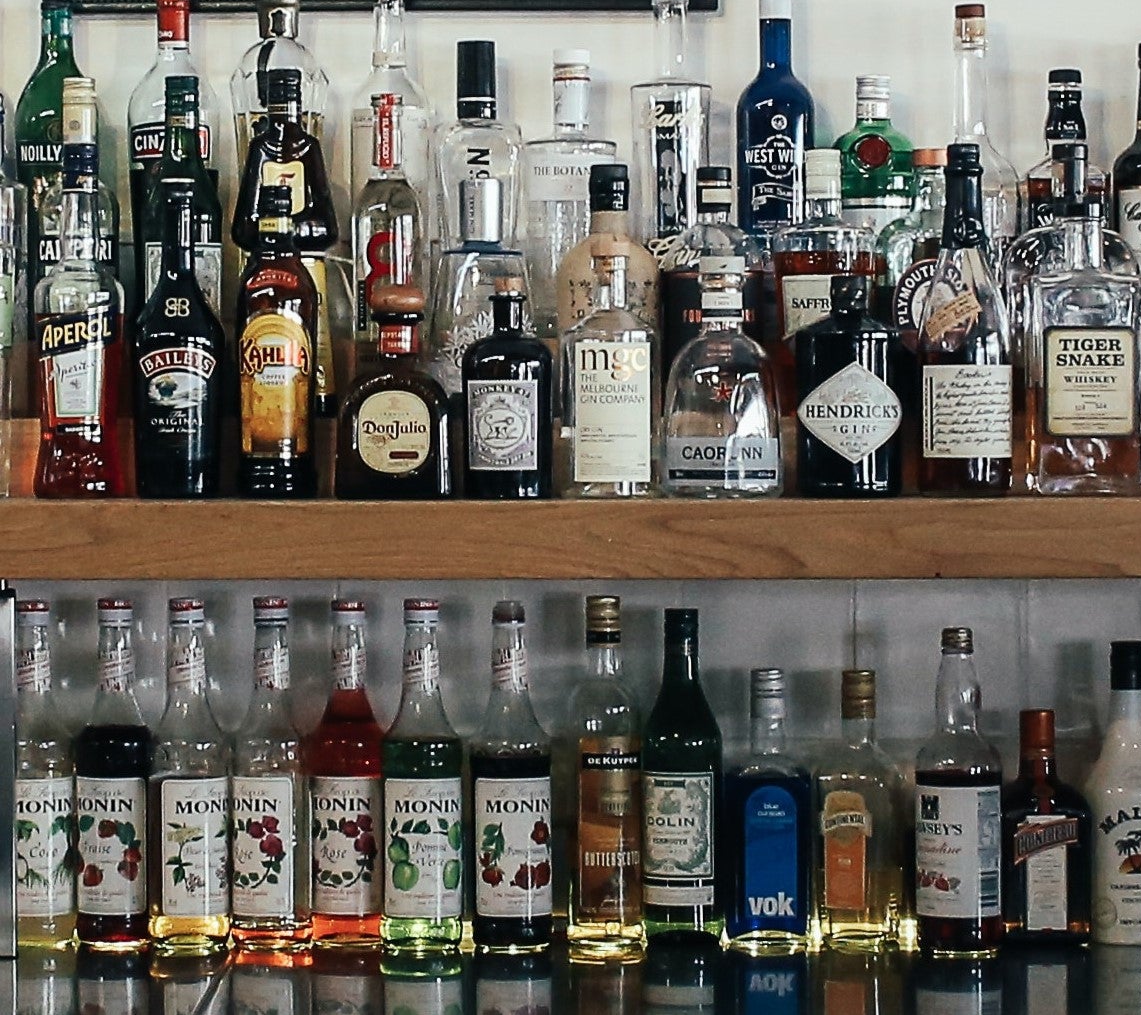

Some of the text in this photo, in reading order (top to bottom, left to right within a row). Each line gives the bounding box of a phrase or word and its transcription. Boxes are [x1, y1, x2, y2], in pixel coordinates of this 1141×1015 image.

[20, 144, 62, 162] NOILLY
[744, 148, 774, 164] WEST
[41, 316, 112, 351] APEROL
[1058, 338, 1122, 352] TIGER
[144, 348, 211, 373] BAILEYS
[1056, 353, 1125, 367] SNAKE
[580, 373, 598, 383] THE
[1063, 375, 1117, 384] WHISKEY
[580, 384, 639, 394] MELBOURNE
[580, 394, 598, 404] GIN
[805, 404, 899, 419] HENDRICK'S
[394, 799, 460, 814] MONIN
[748, 891, 796, 917] vok
